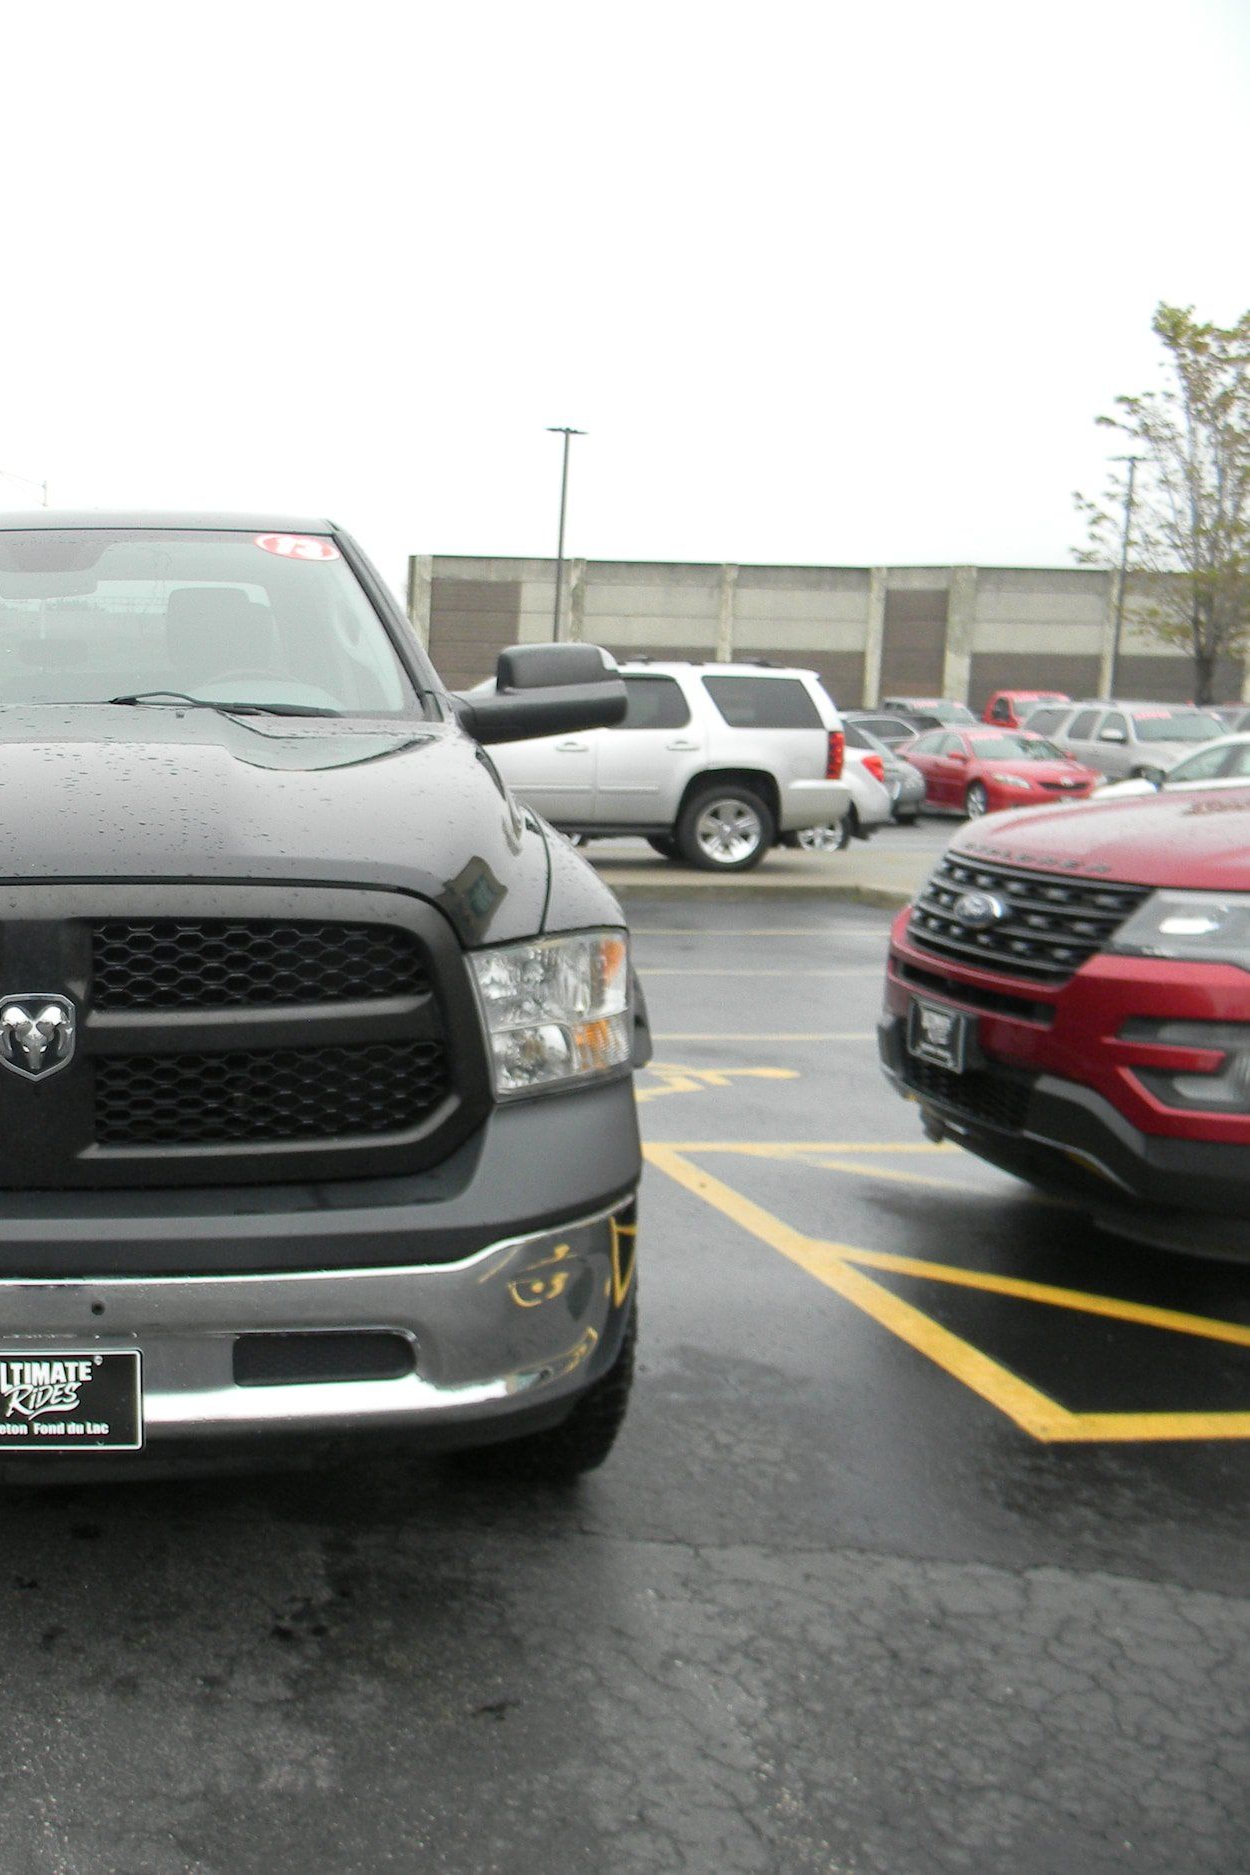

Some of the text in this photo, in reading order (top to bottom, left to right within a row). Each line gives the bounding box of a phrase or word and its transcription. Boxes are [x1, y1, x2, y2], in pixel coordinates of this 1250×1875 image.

[33, 1421, 65, 1435] Fond
[66, 1421, 85, 1435] du
[86, 1422, 110, 1435] Lac
